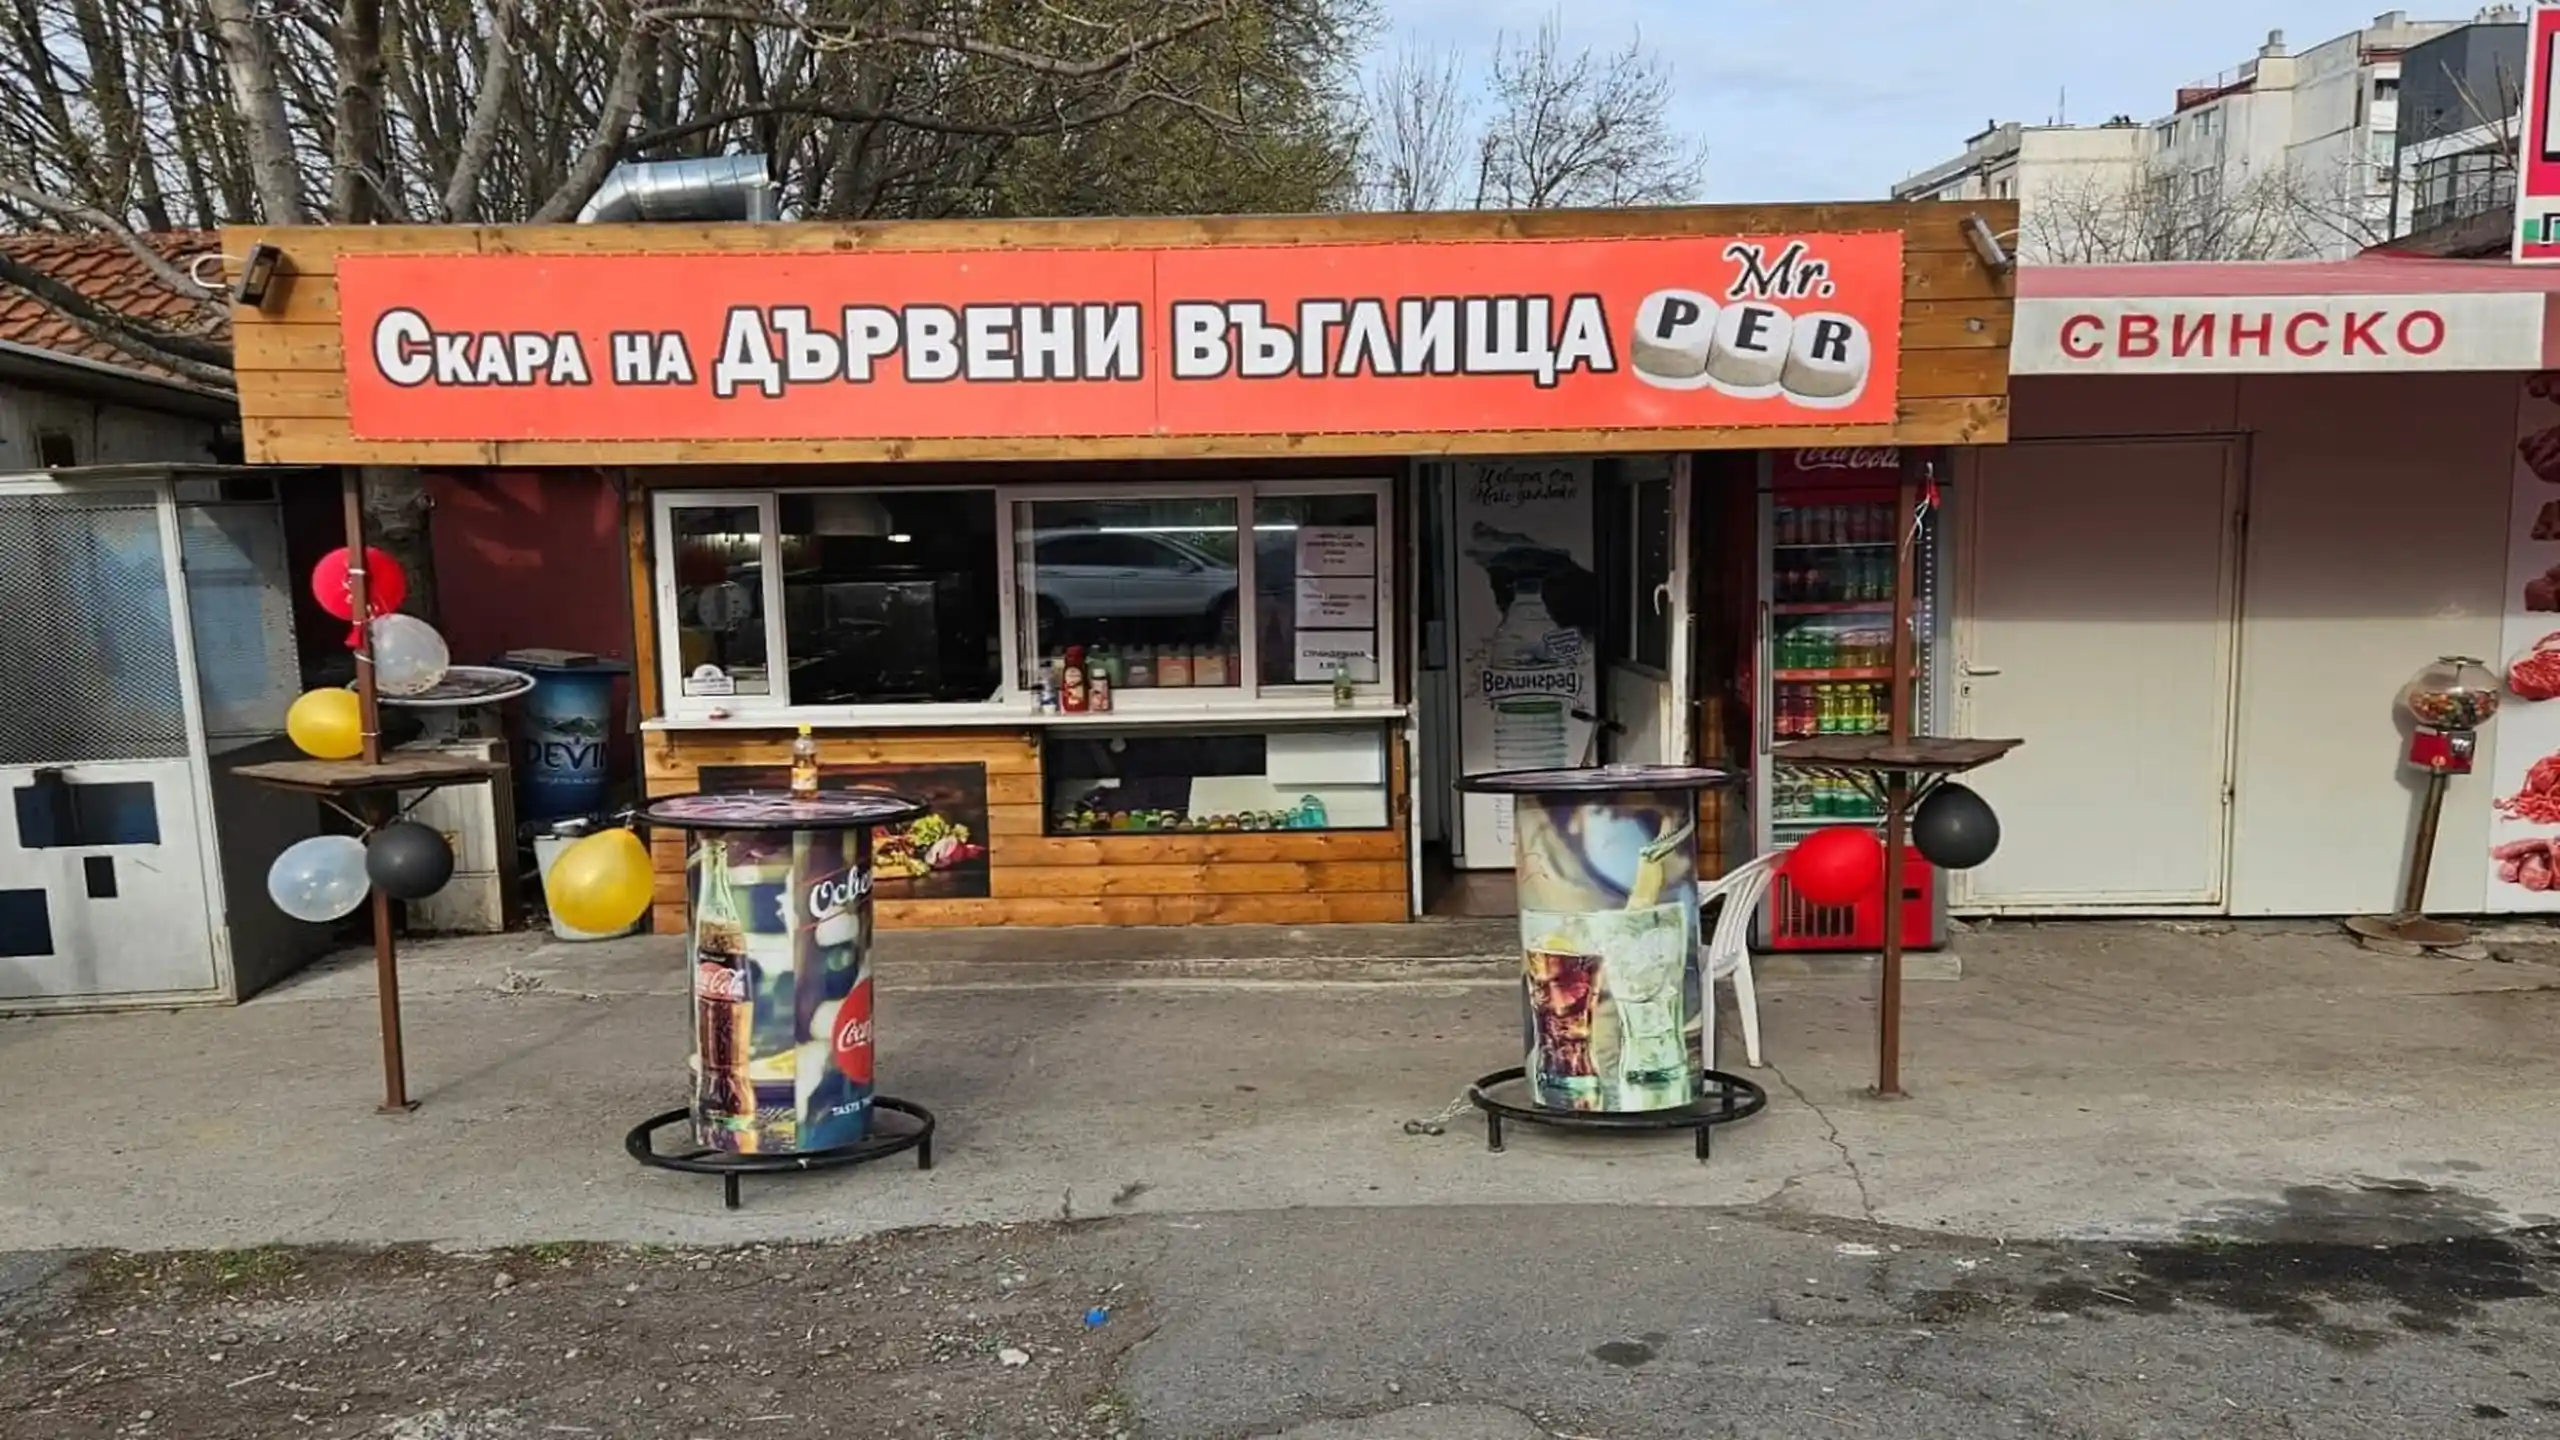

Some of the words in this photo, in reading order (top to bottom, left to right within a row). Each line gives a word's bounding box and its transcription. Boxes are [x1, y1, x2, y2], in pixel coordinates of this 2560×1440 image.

[1726, 243, 1834, 297] Mr.
[712, 302, 1143, 398] ДЪРВЕНИ
[1169, 294, 1617, 387] ВЪГЛИЩА
[1656, 297, 1852, 362] PER
[2060, 309, 2446, 360] СВИНСКО
